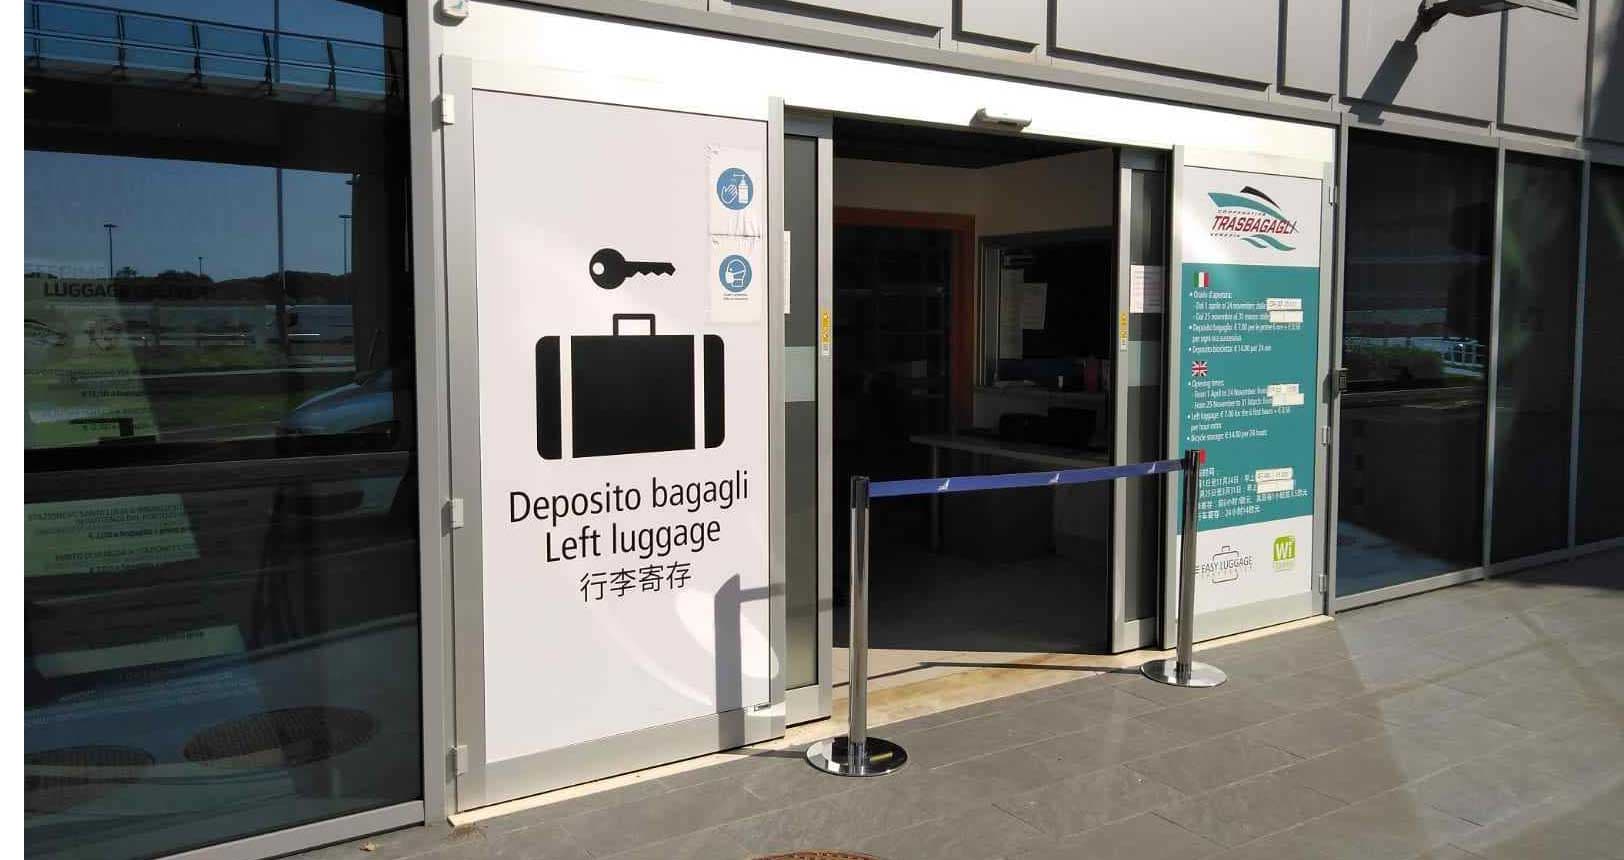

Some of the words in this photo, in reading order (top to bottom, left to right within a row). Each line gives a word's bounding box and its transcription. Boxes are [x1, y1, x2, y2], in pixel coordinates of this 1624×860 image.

[1211, 215, 1297, 235] TRASBAGAGLI
[510, 482, 641, 527] Deposito
[652, 470, 748, 513] bagagli
[546, 525, 601, 563] Left
[612, 519, 721, 559] luggage
[579, 561, 692, 603] 行李寄存
[1201, 563, 1218, 575] EASY
[1219, 555, 1253, 570] LUGGAGE
